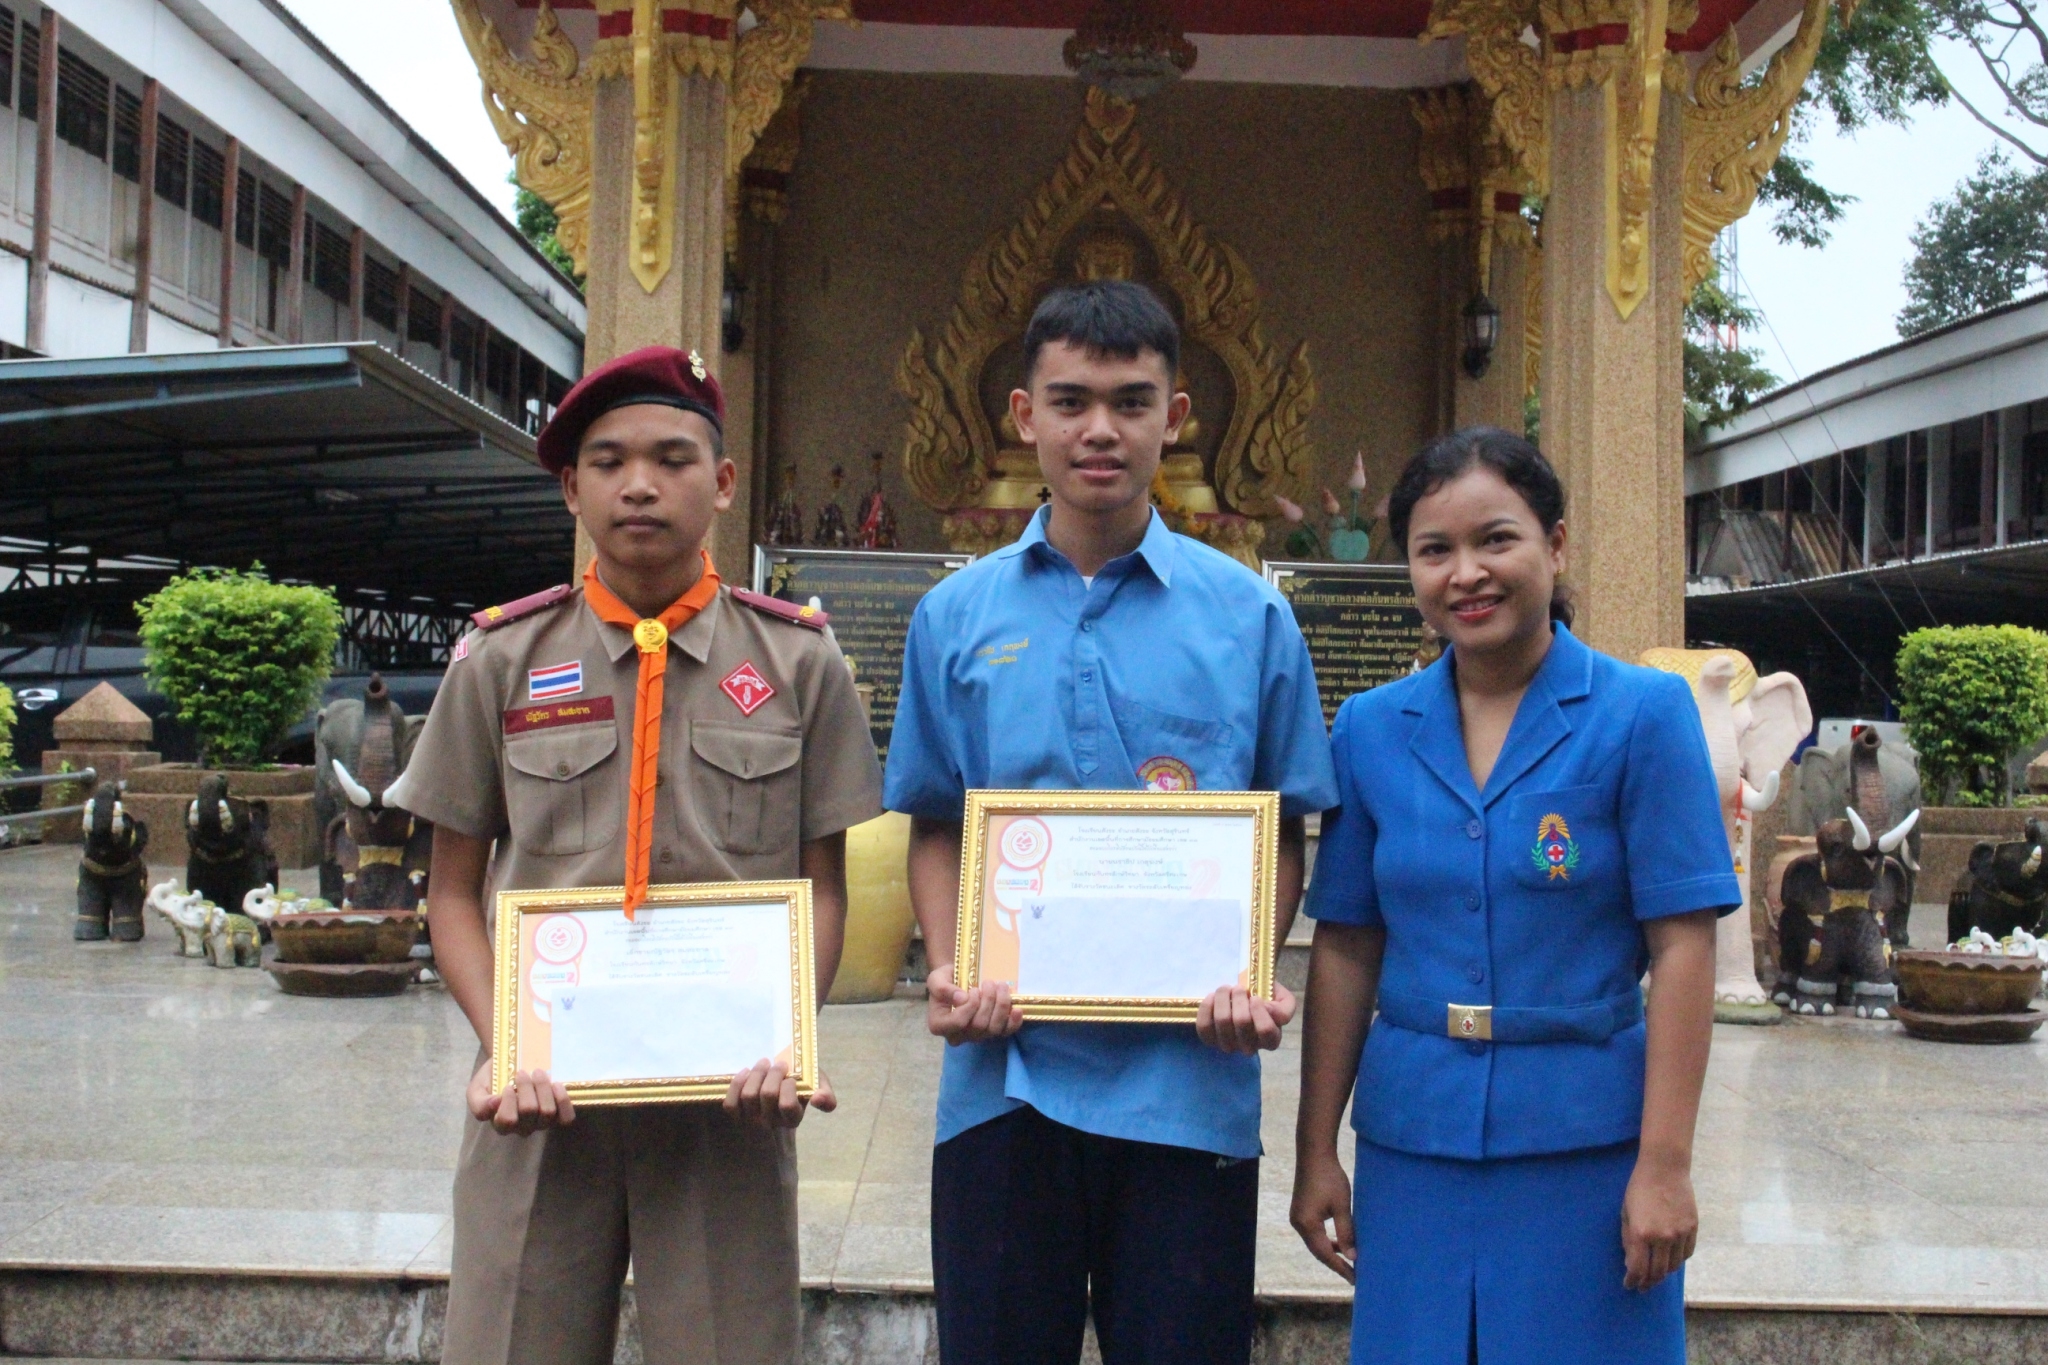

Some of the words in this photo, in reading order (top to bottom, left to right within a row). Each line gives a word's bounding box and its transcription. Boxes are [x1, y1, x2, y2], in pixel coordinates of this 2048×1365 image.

[1341, 610, 1359, 621] กล่าว
[1362, 610, 1380, 622] นะโม
[1392, 614, 1403, 622] จบ
